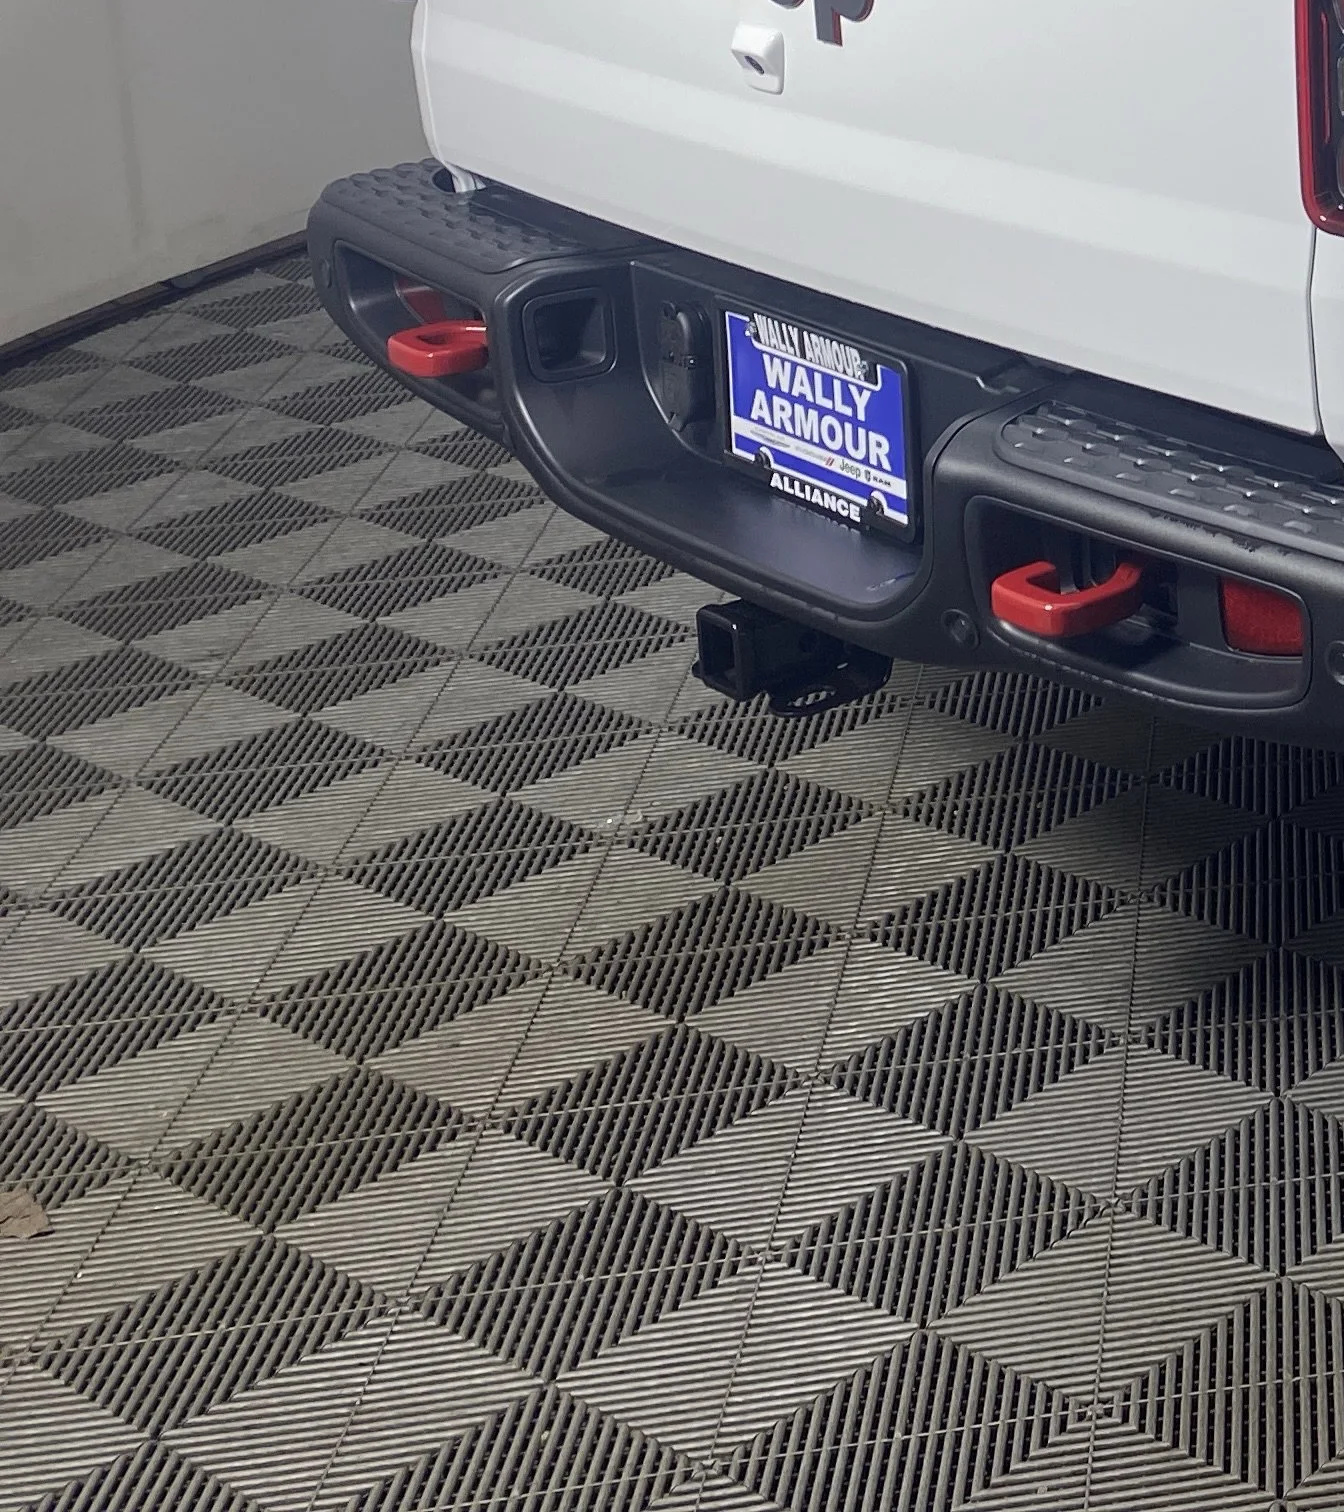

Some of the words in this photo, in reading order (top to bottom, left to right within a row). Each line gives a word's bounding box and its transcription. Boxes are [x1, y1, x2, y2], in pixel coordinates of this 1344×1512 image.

[753, 313, 800, 359] WALLY
[803, 330, 866, 381] ARMOUR
[763, 353, 871, 422] WALLY
[750, 389, 892, 471] ARMOUR
[769, 472, 861, 523] ALLIANCE
[839, 458, 861, 480] Jeep
